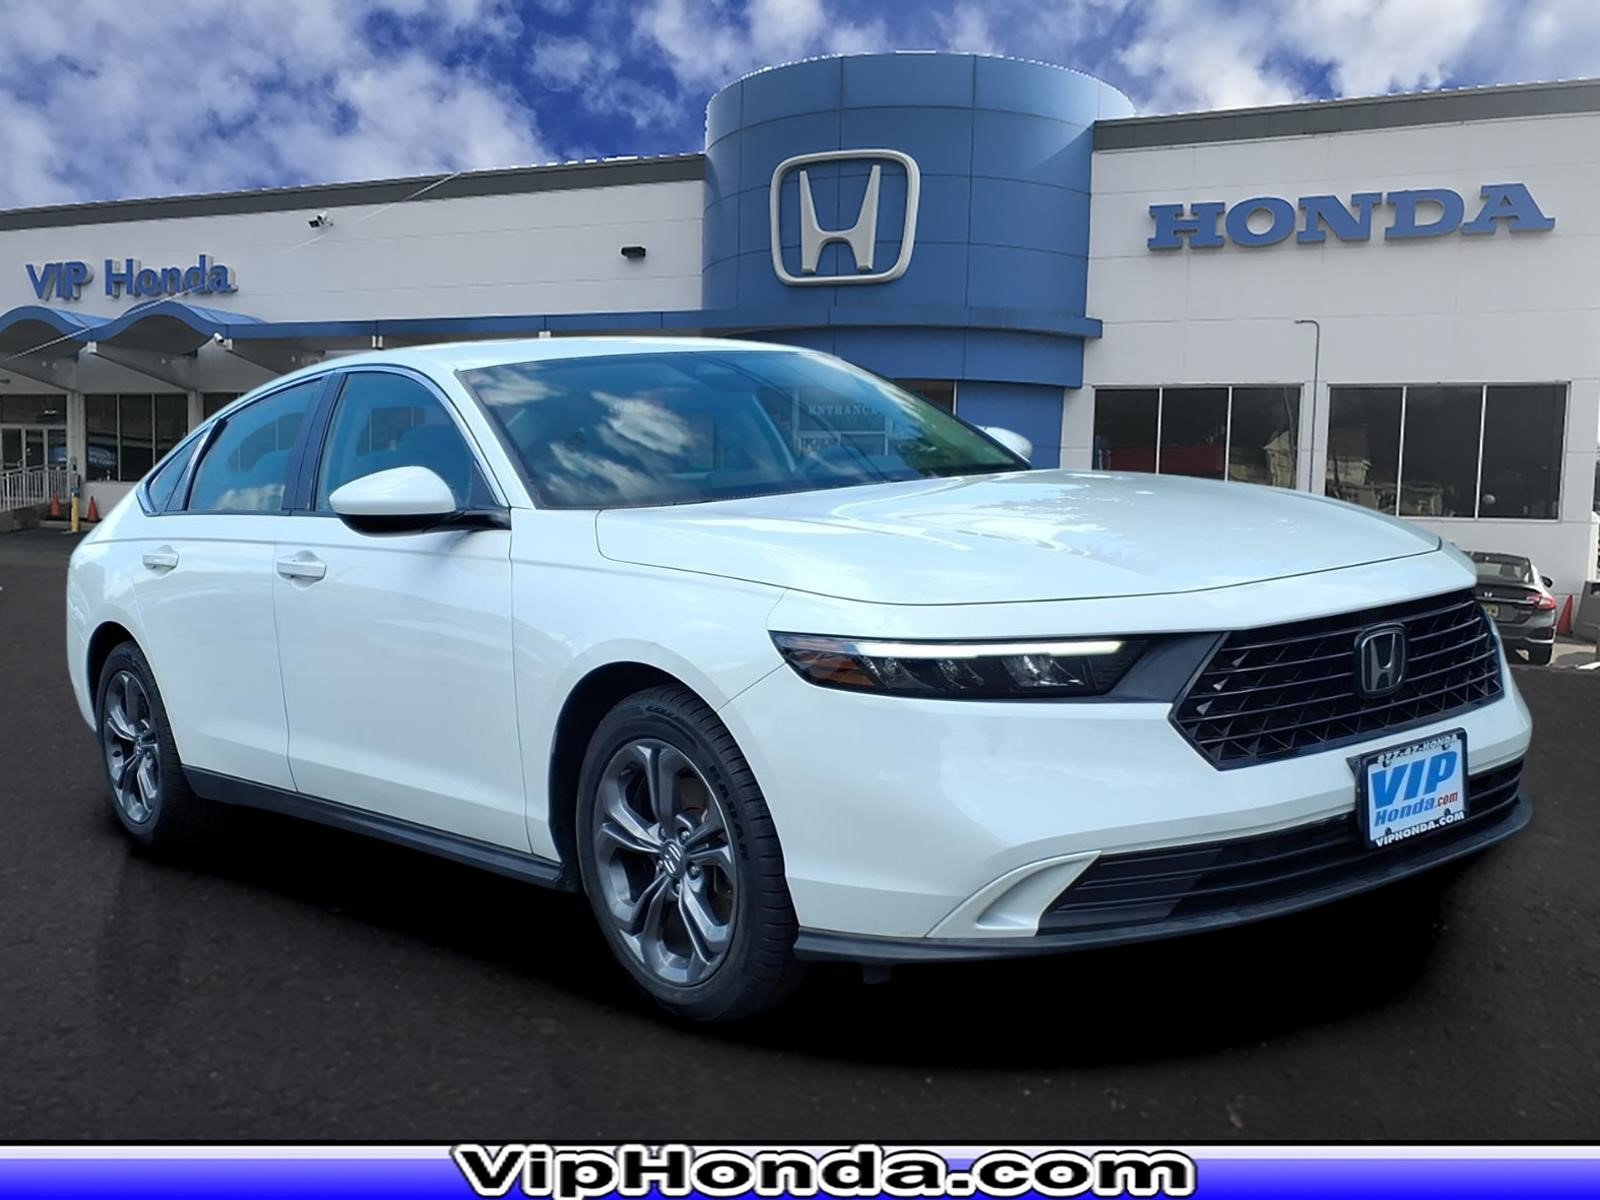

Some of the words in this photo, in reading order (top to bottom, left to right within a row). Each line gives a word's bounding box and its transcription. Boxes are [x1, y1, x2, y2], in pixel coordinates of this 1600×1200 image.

[1147, 183, 1556, 251] HONDA
[25, 261, 92, 301] VIP
[104, 254, 238, 299] Honda
[1371, 751, 1457, 810] VIP
[1374, 792, 1458, 827] Honda.com
[1375, 811, 1465, 847] VIPHONDA.COM
